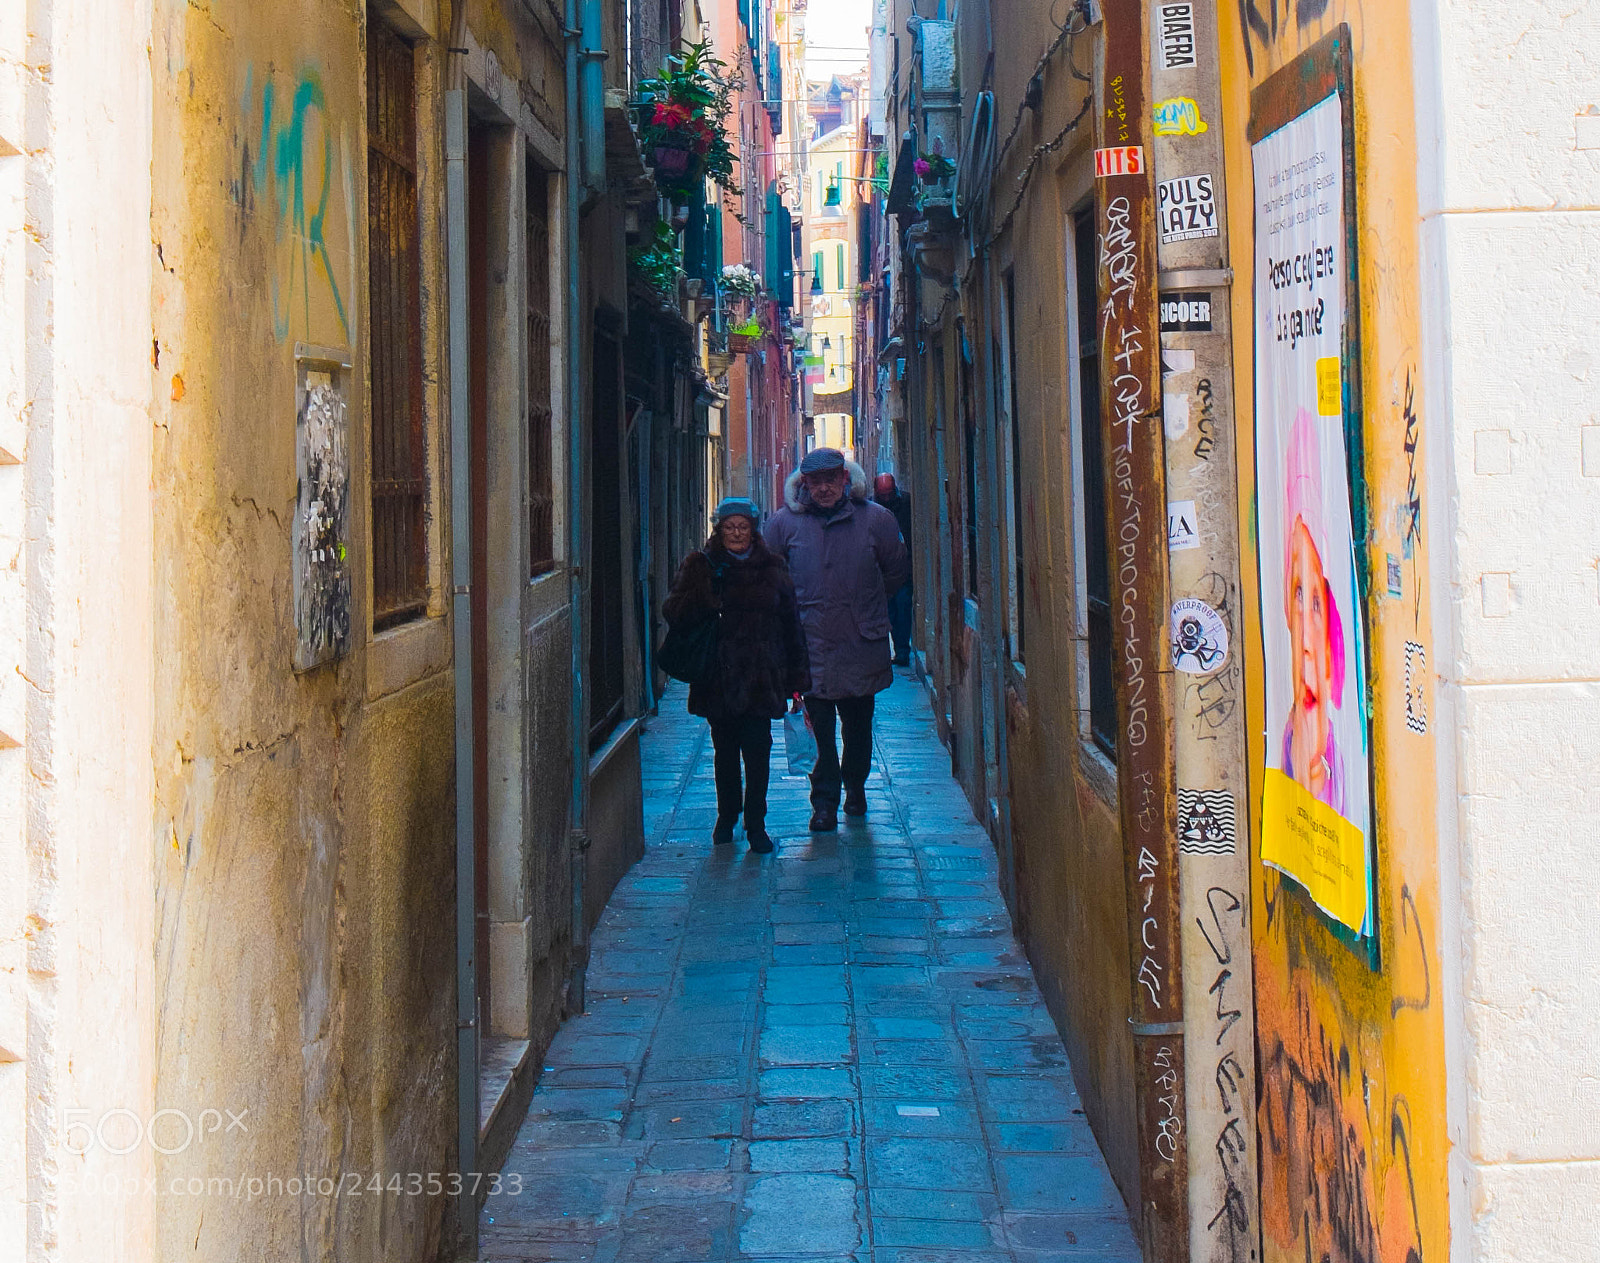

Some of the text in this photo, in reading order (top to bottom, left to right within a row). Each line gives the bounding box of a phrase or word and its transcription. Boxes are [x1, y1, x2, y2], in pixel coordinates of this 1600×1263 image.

[1162, 5, 1194, 68] BIAFRA
[1159, 177, 1212, 209] PULS
[1161, 202, 1214, 234] LAZY
